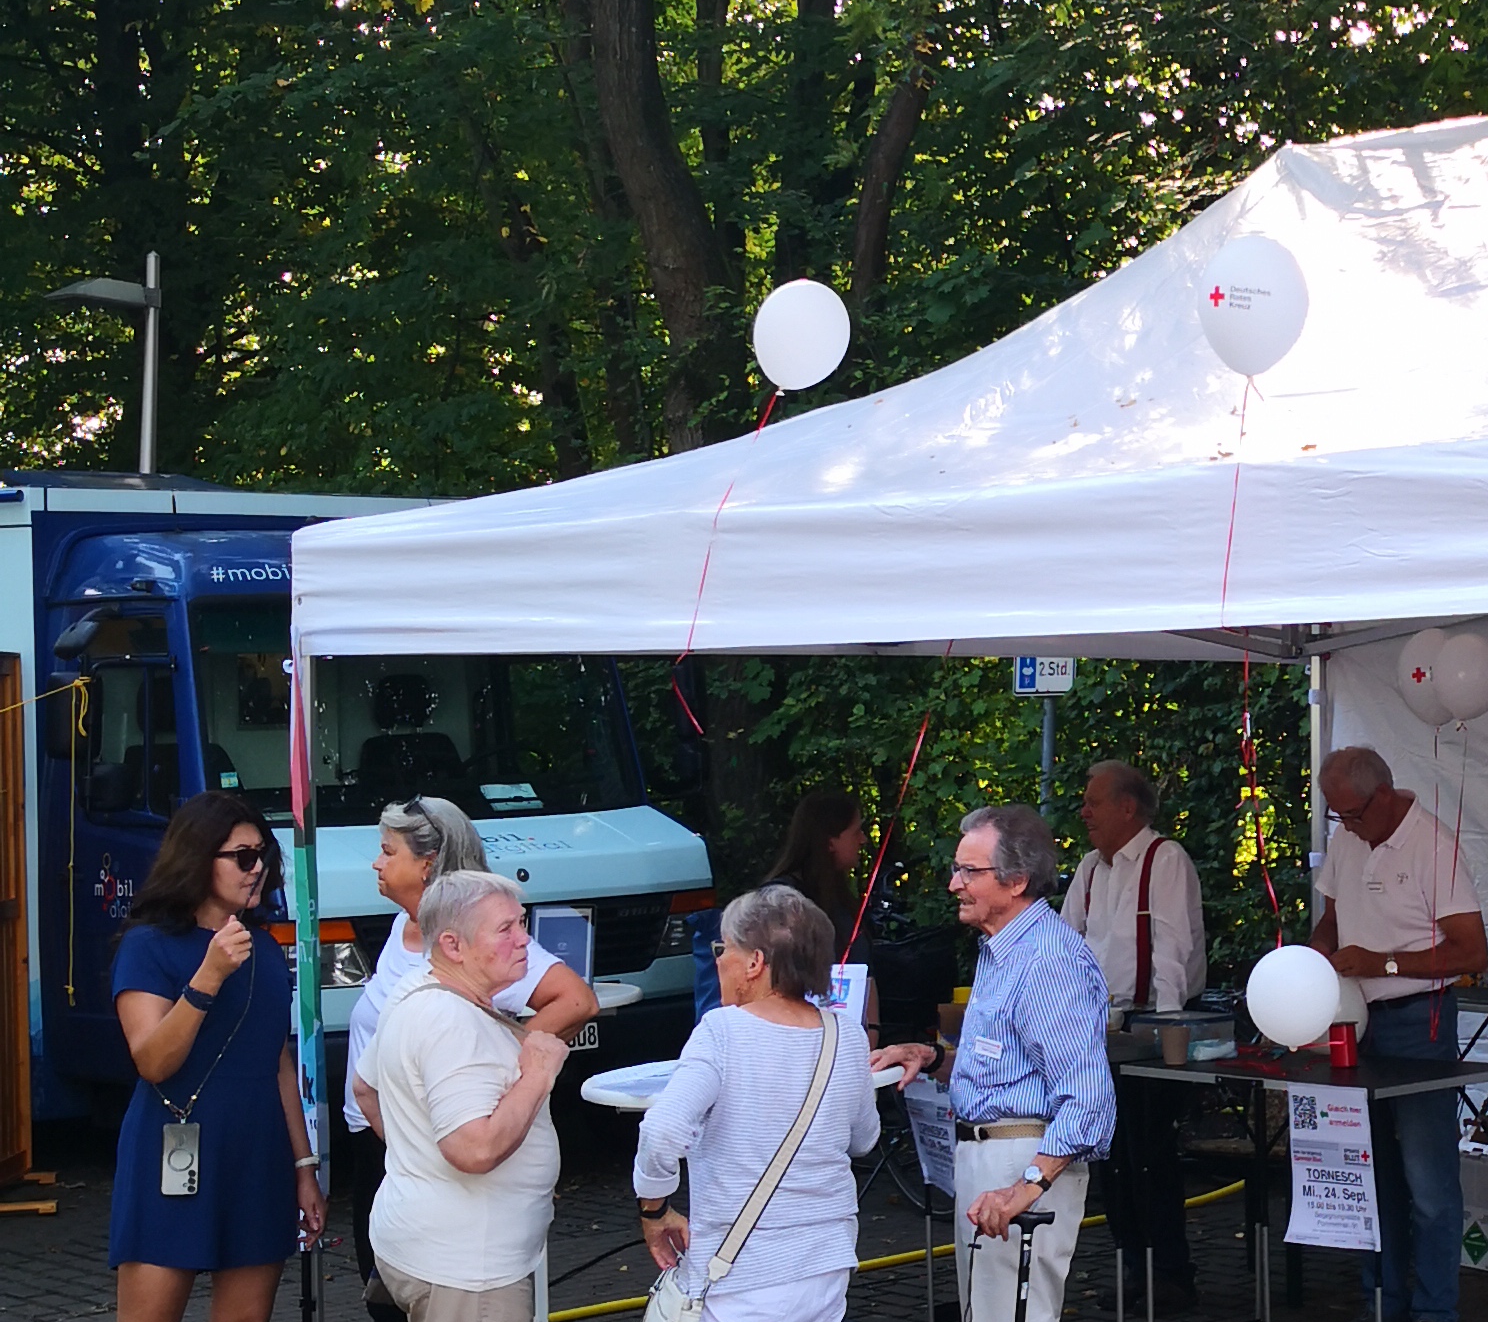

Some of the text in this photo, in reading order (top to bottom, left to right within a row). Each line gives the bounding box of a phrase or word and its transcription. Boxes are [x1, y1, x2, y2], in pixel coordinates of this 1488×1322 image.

[1306, 1168, 1363, 1184] TORNESCH
[1324, 1187, 1340, 1199] 24.
[1342, 1188, 1369, 1204] Sept.
